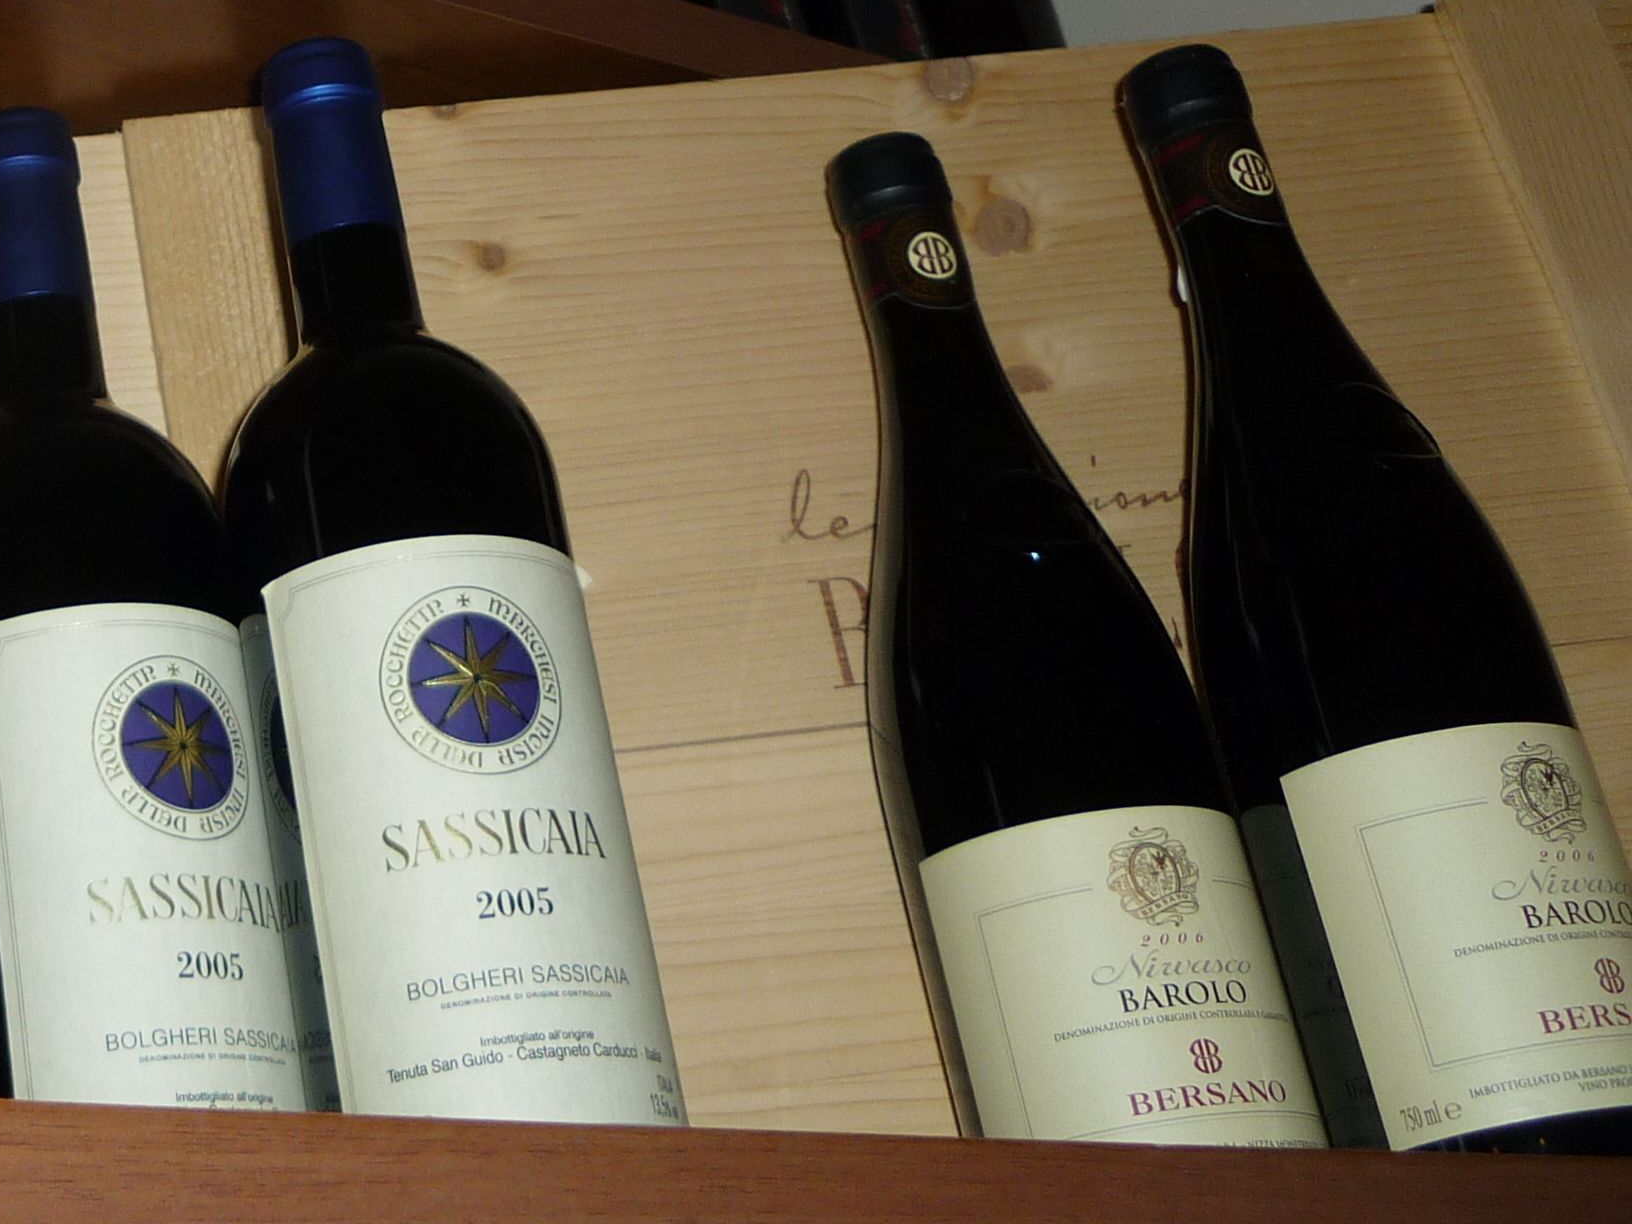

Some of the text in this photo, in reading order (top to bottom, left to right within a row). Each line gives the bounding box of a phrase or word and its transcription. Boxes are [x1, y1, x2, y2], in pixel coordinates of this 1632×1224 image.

[380, 806, 607, 873] SASSICAIA
[1491, 866, 1632, 901] Nirvasc
[85, 872, 280, 933] SASSICAIA
[475, 887, 554, 920] 2005
[1519, 898, 1632, 929] BAROLO
[1139, 931, 1206, 947] 2006
[176, 950, 244, 981] 2005
[406, 964, 632, 1002] BOLGHERI SASSICAIA
[1117, 978, 1247, 1014] BAROLO
[105, 1027, 218, 1052] BOLGHERI
[479, 1030, 546, 1048] Imbottigliato
[1054, 1018, 1141, 1043] DENOMINAZIONE
[1143, 1014, 1155, 1026] DI
[1158, 1011, 1199, 1024] ORIGINE
[387, 1063, 428, 1084] Tenuta
[431, 1057, 459, 1074] San
[461, 1048, 504, 1069] Guido
[516, 1044, 590, 1065] Castagneto
[593, 1041, 638, 1060] Carducci
[1126, 1078, 1288, 1117] BERSANO
[1469, 1072, 1561, 1099] IMBOTTIGLIATO
[1563, 1069, 1580, 1082] DA
[1578, 1078, 1608, 1092] VINO
[1400, 1104, 1424, 1132] 750
[1424, 1100, 1442, 1126] ml
